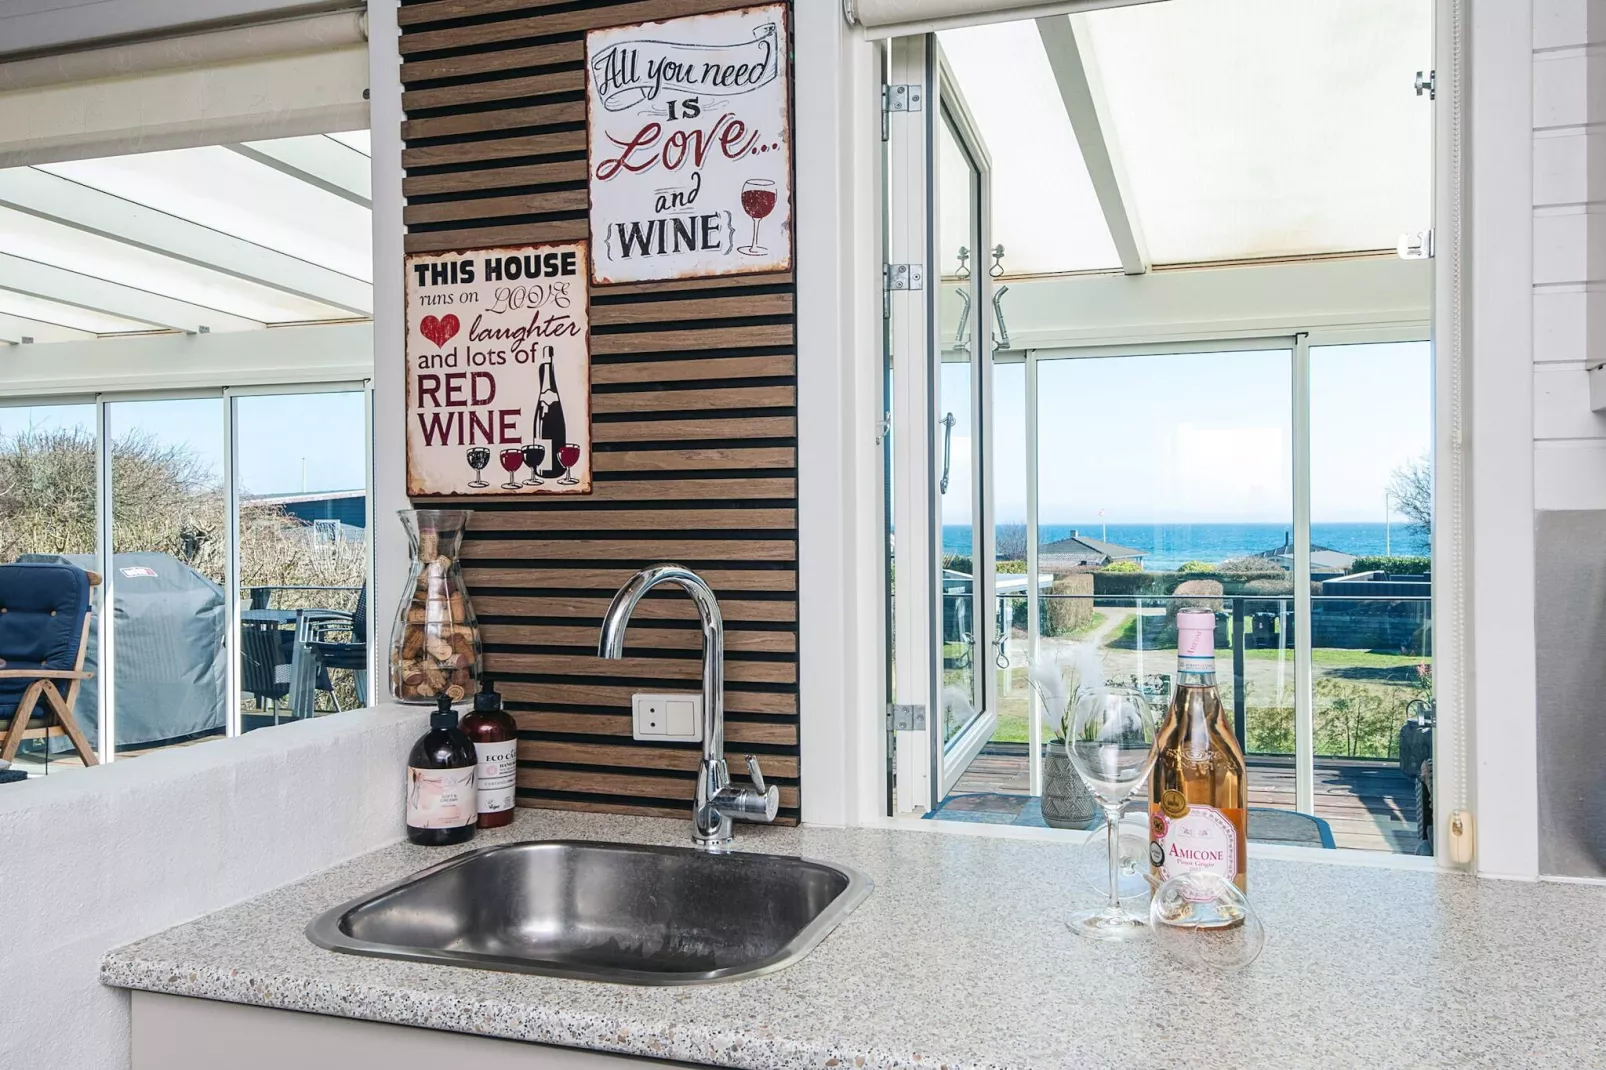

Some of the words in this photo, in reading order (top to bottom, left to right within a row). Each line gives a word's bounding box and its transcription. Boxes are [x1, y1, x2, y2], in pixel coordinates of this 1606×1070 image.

[594, 47, 640, 95] All
[647, 56, 697, 100] you
[701, 40, 771, 87] need
[666, 97, 701, 121] IS
[655, 172, 701, 213] and
[414, 260, 475, 286] THIS
[485, 252, 576, 281] HOUSE
[419, 292, 454, 306] runs
[459, 291, 479, 304] on
[485, 282, 571, 314] LOVE
[469, 310, 581, 352] laughter
[418, 347, 457, 369] and
[467, 346, 506, 367] lots
[515, 342, 539, 364] of
[417, 371, 496, 408] RED
[417, 408, 522, 446] WINE
[486, 754, 504, 762] ECO
[1195, 860, 1215, 868] Grigio
